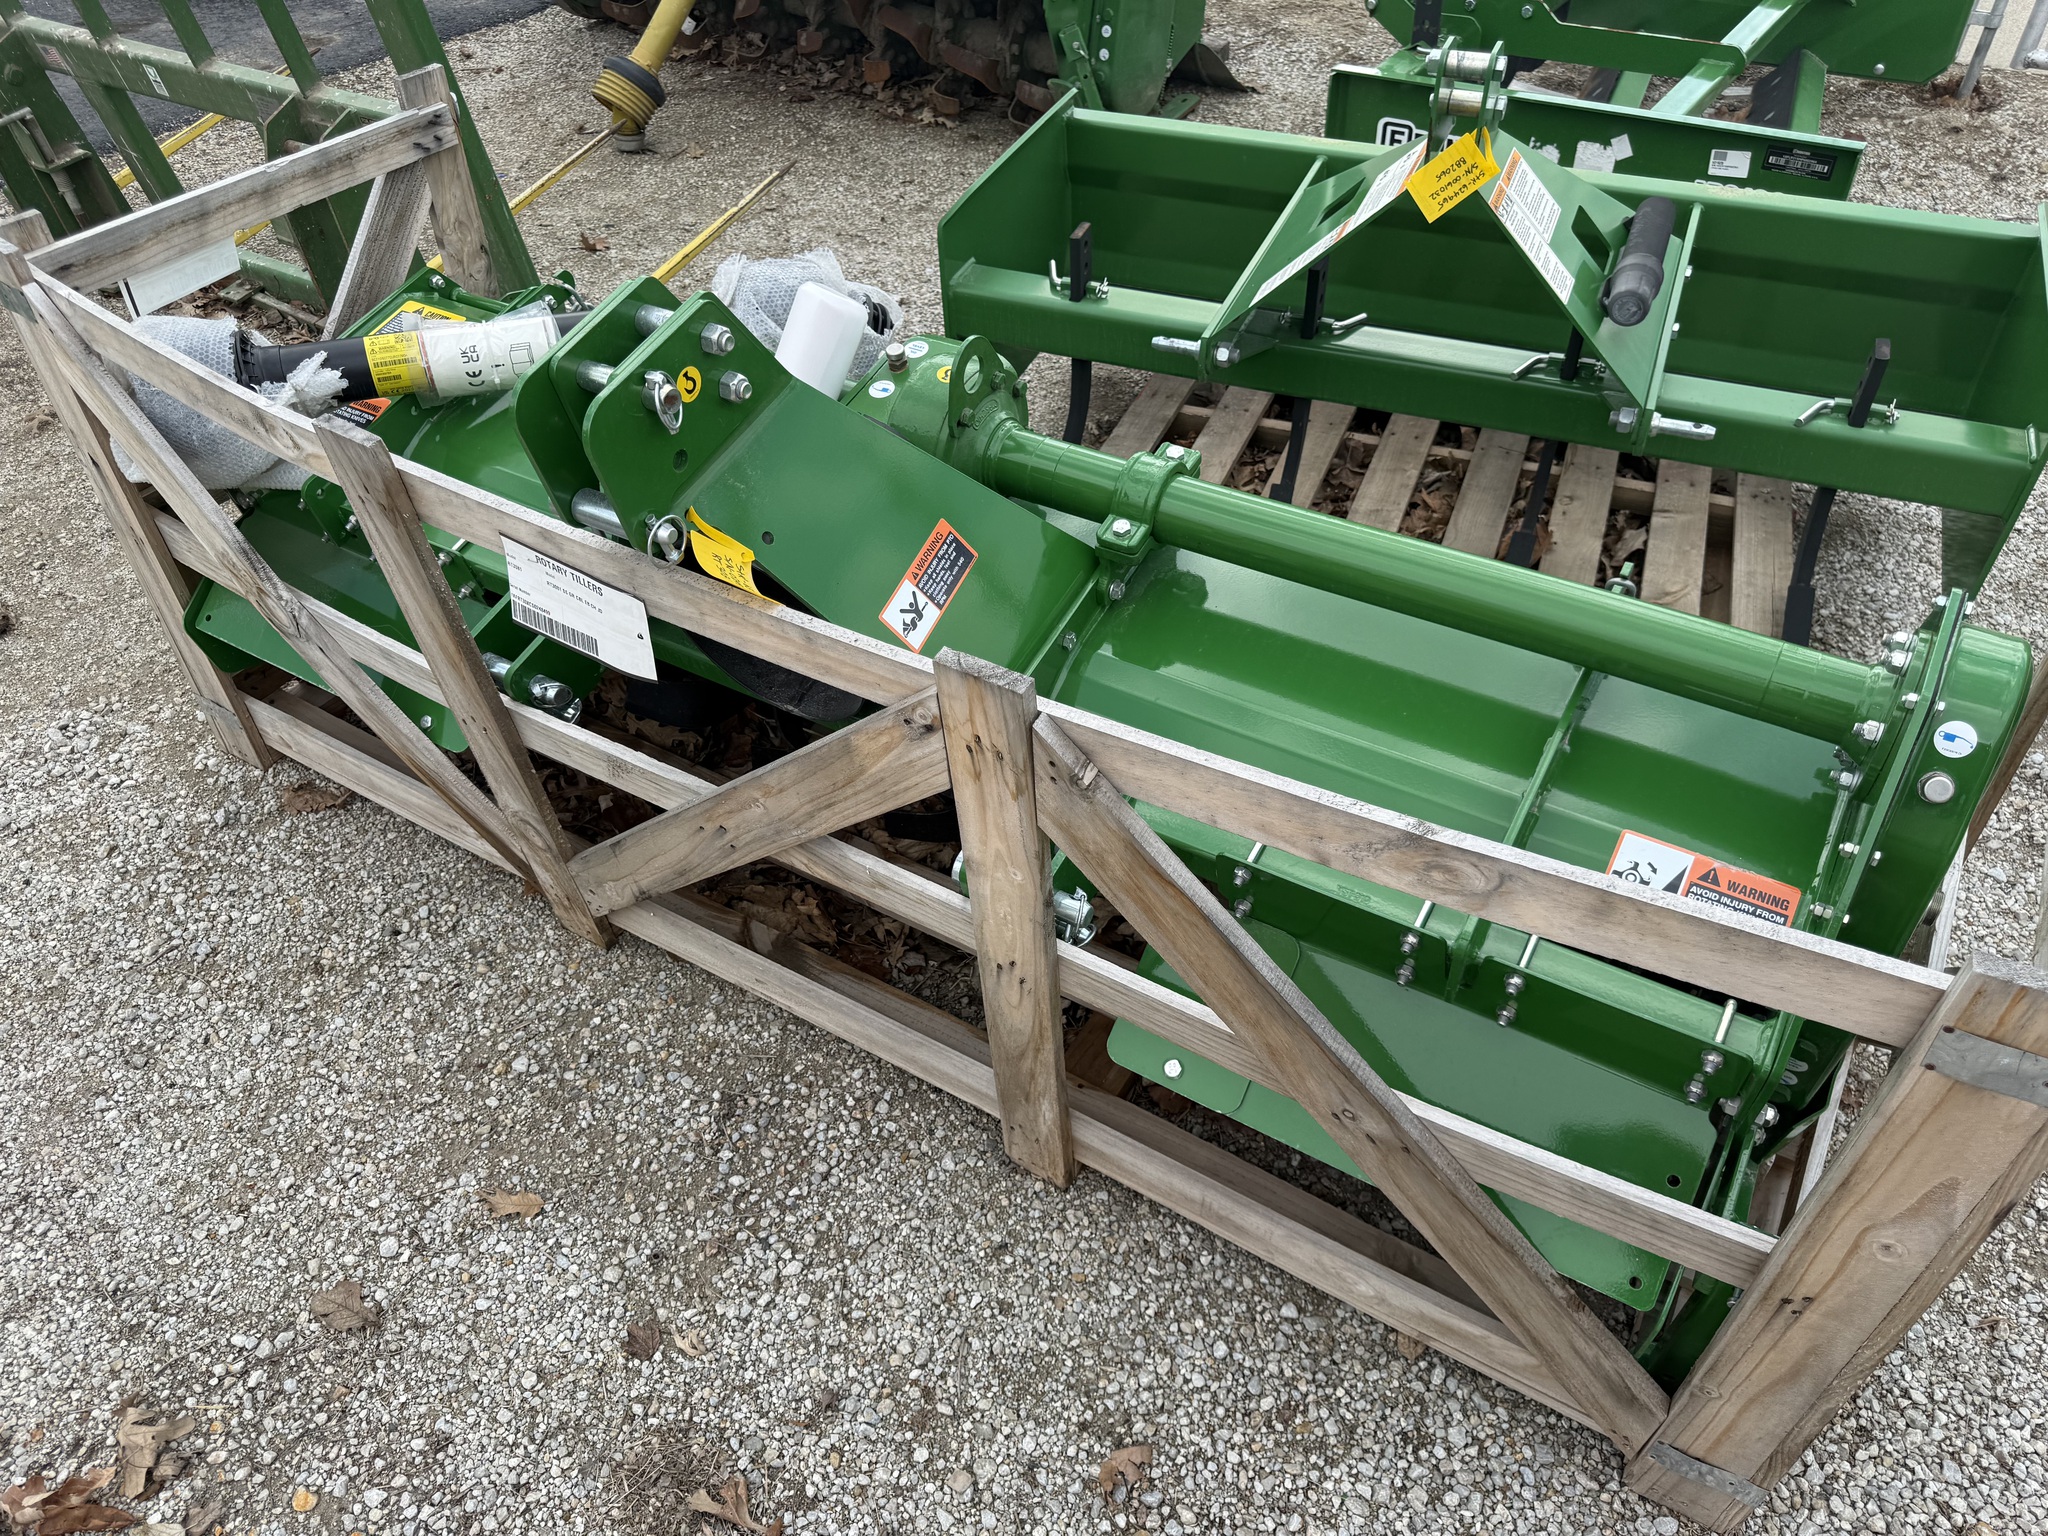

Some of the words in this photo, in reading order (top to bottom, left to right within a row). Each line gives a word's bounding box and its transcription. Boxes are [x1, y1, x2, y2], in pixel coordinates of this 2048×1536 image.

[915, 532, 944, 572] WARNING
[918, 575, 929, 588] AVOID
[928, 558, 938, 575] INJURY
[938, 544, 948, 558] FROM
[946, 534, 954, 544] PTO
[535, 555, 568, 577] ROTARY
[570, 572, 603, 597] TILLERS
[1690, 886, 1719, 900] AVOID
[1721, 895, 1755, 913] INJURY
[1755, 909, 1785, 924] FROM
[1726, 879, 1790, 911] WARNING
